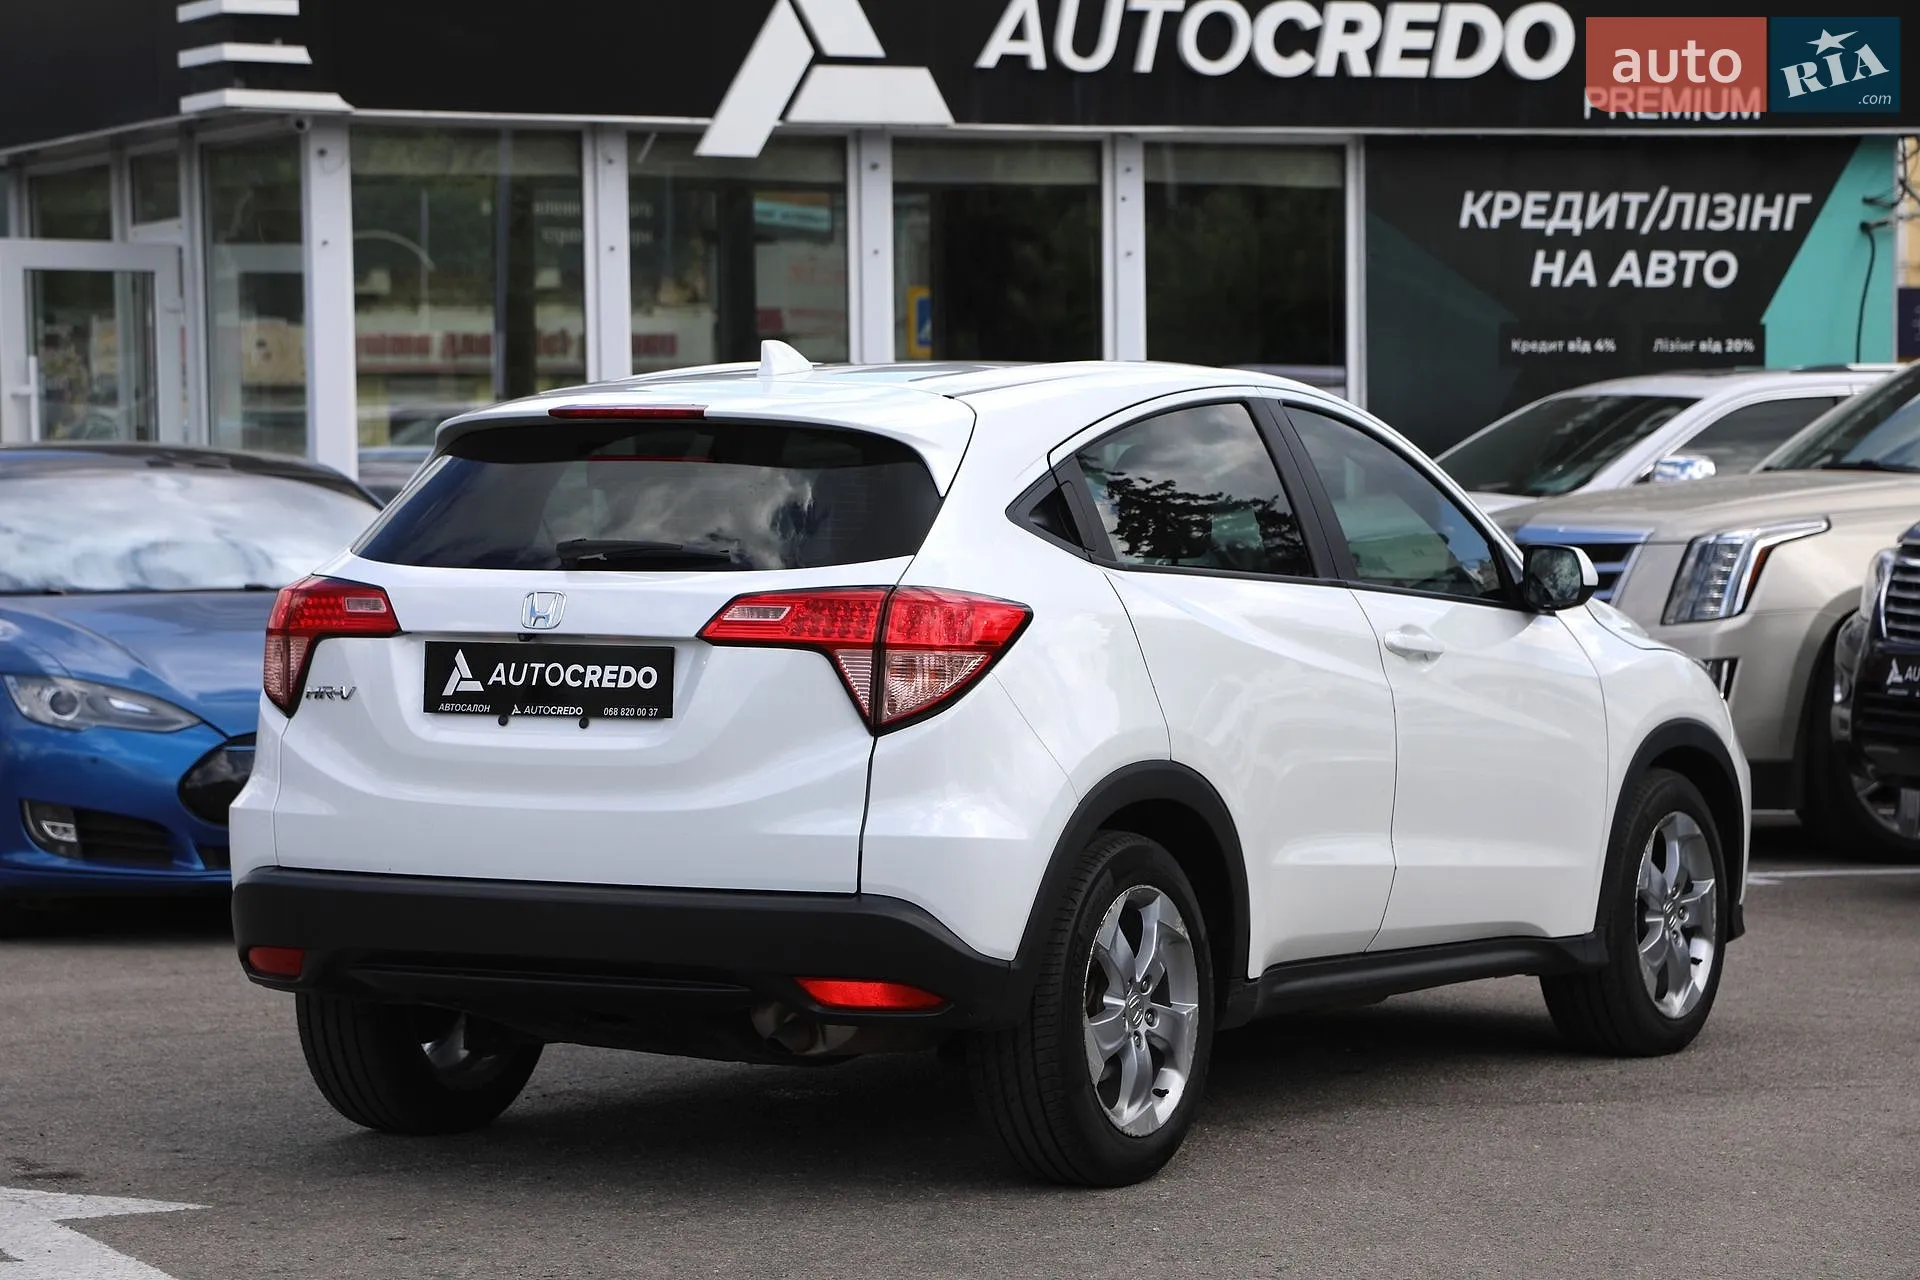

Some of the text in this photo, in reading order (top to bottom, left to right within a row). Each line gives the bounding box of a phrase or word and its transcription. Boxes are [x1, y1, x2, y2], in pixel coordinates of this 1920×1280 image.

[974, 0, 1576, 80] AUTOCREDO
[1583, 86, 1762, 121] PREMIUM
[1458, 186, 1813, 236] КРЕДИТ/ЛІЗІНГ
[1529, 249, 1740, 289] НА АВТО
[1510, 337, 1617, 355] Кредит від 4%
[1698, 337, 1723, 354] від
[1724, 338, 1756, 353] 20%
[486, 662, 659, 690] AUTOCREDO
[305, 685, 358, 701] HR-V
[438, 702, 492, 714] АВТОСАЛОН
[523, 704, 584, 716] AUTOCREDO
[603, 706, 659, 718] 068 820 00 37
